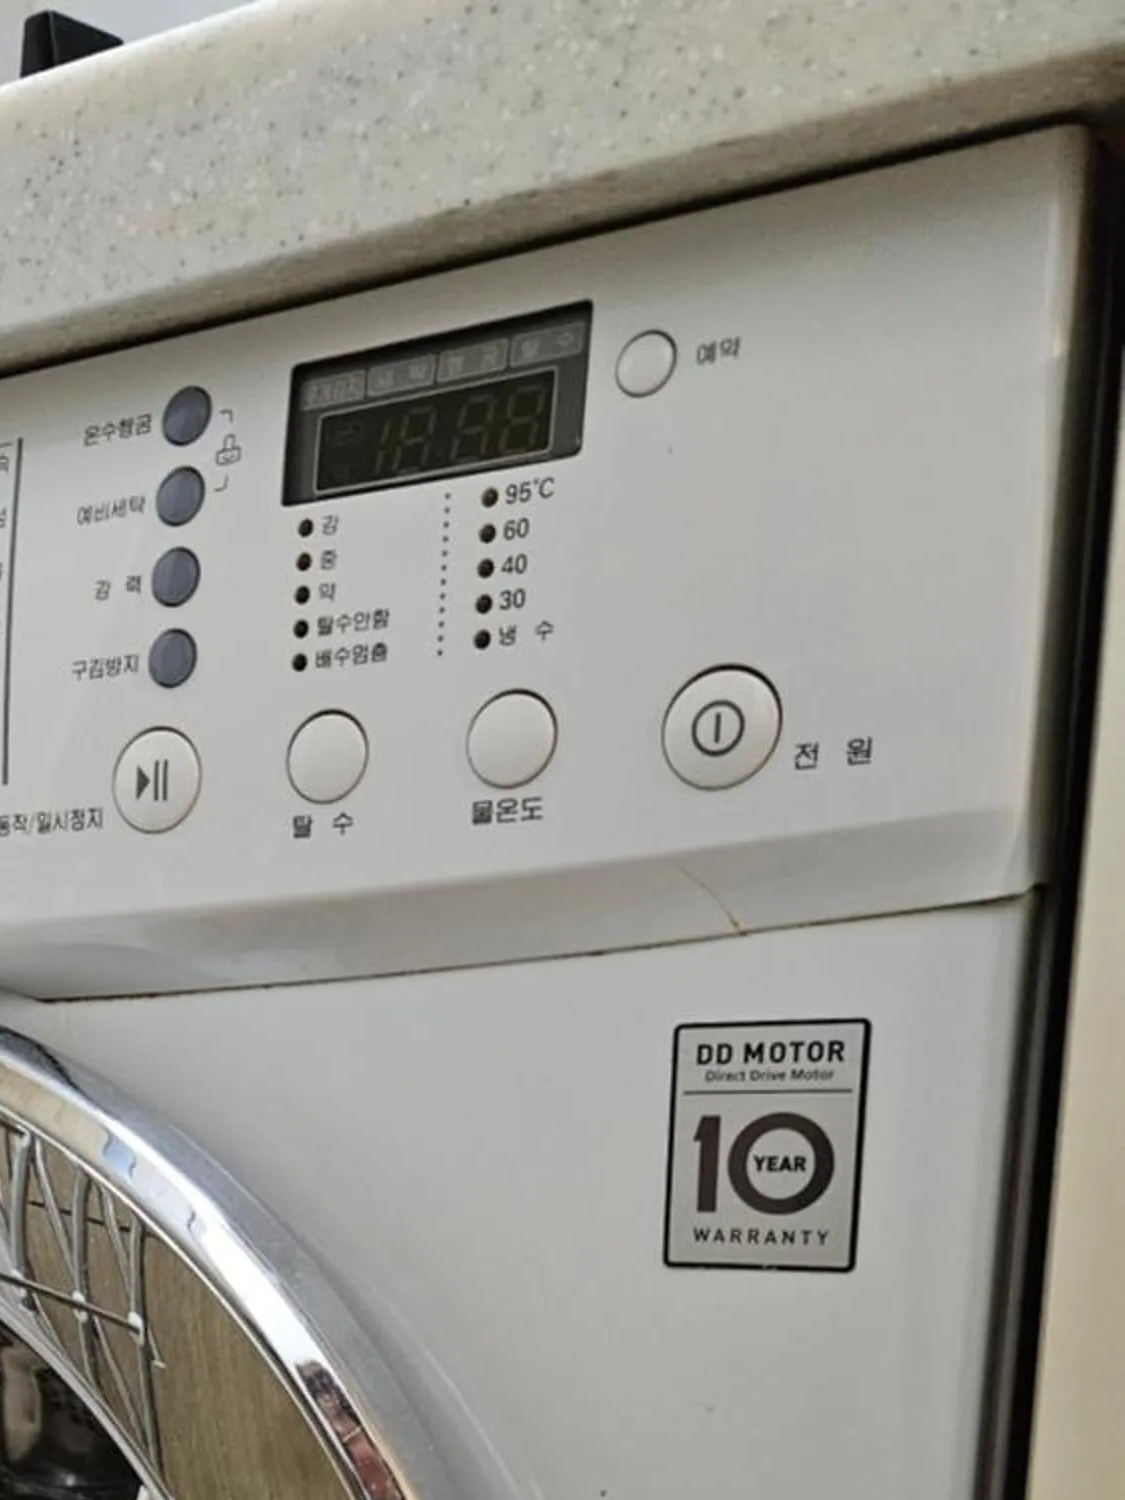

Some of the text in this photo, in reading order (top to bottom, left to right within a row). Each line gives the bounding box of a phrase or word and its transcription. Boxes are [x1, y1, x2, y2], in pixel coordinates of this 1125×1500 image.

[696, 335, 742, 366] 예약
[76, 495, 146, 525] 예비세탁
[503, 517, 530, 541] 60
[501, 553, 528, 575] 40
[318, 582, 337, 602] 약
[499, 588, 526, 611] 30
[317, 608, 390, 637] 탈수안함
[72, 653, 139, 680] 구김방지
[471, 797, 547, 826] 물온도
[696, 1040, 845, 1066] DD MOTOR
[704, 1068, 834, 1083] Direct Drive Motor
[693, 1111, 835, 1215] 10
[752, 1155, 807, 1172] YEAR
[693, 1226, 830, 1246] WARRANTY
